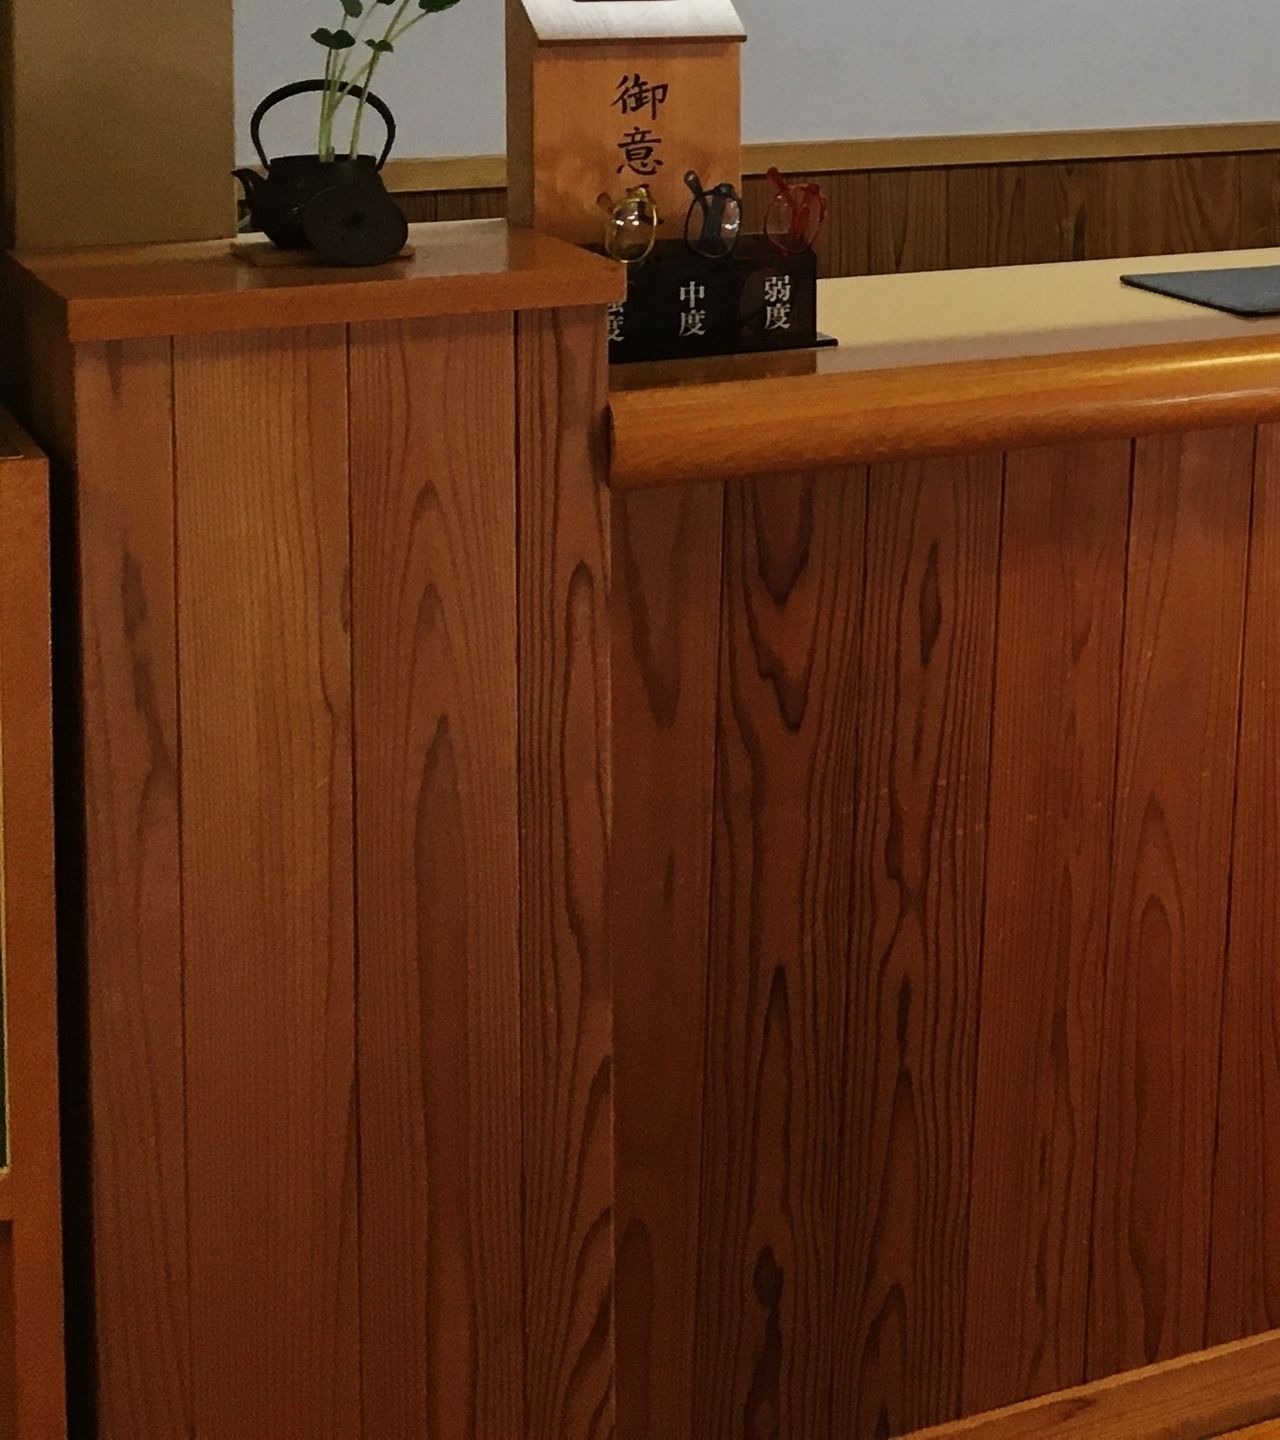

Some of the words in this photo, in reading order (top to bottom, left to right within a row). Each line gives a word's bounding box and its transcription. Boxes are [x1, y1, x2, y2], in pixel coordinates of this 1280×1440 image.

[607, 302, 625, 342] 度
[678, 280, 707, 337] 中度
[764, 274, 792, 331] 弱度
